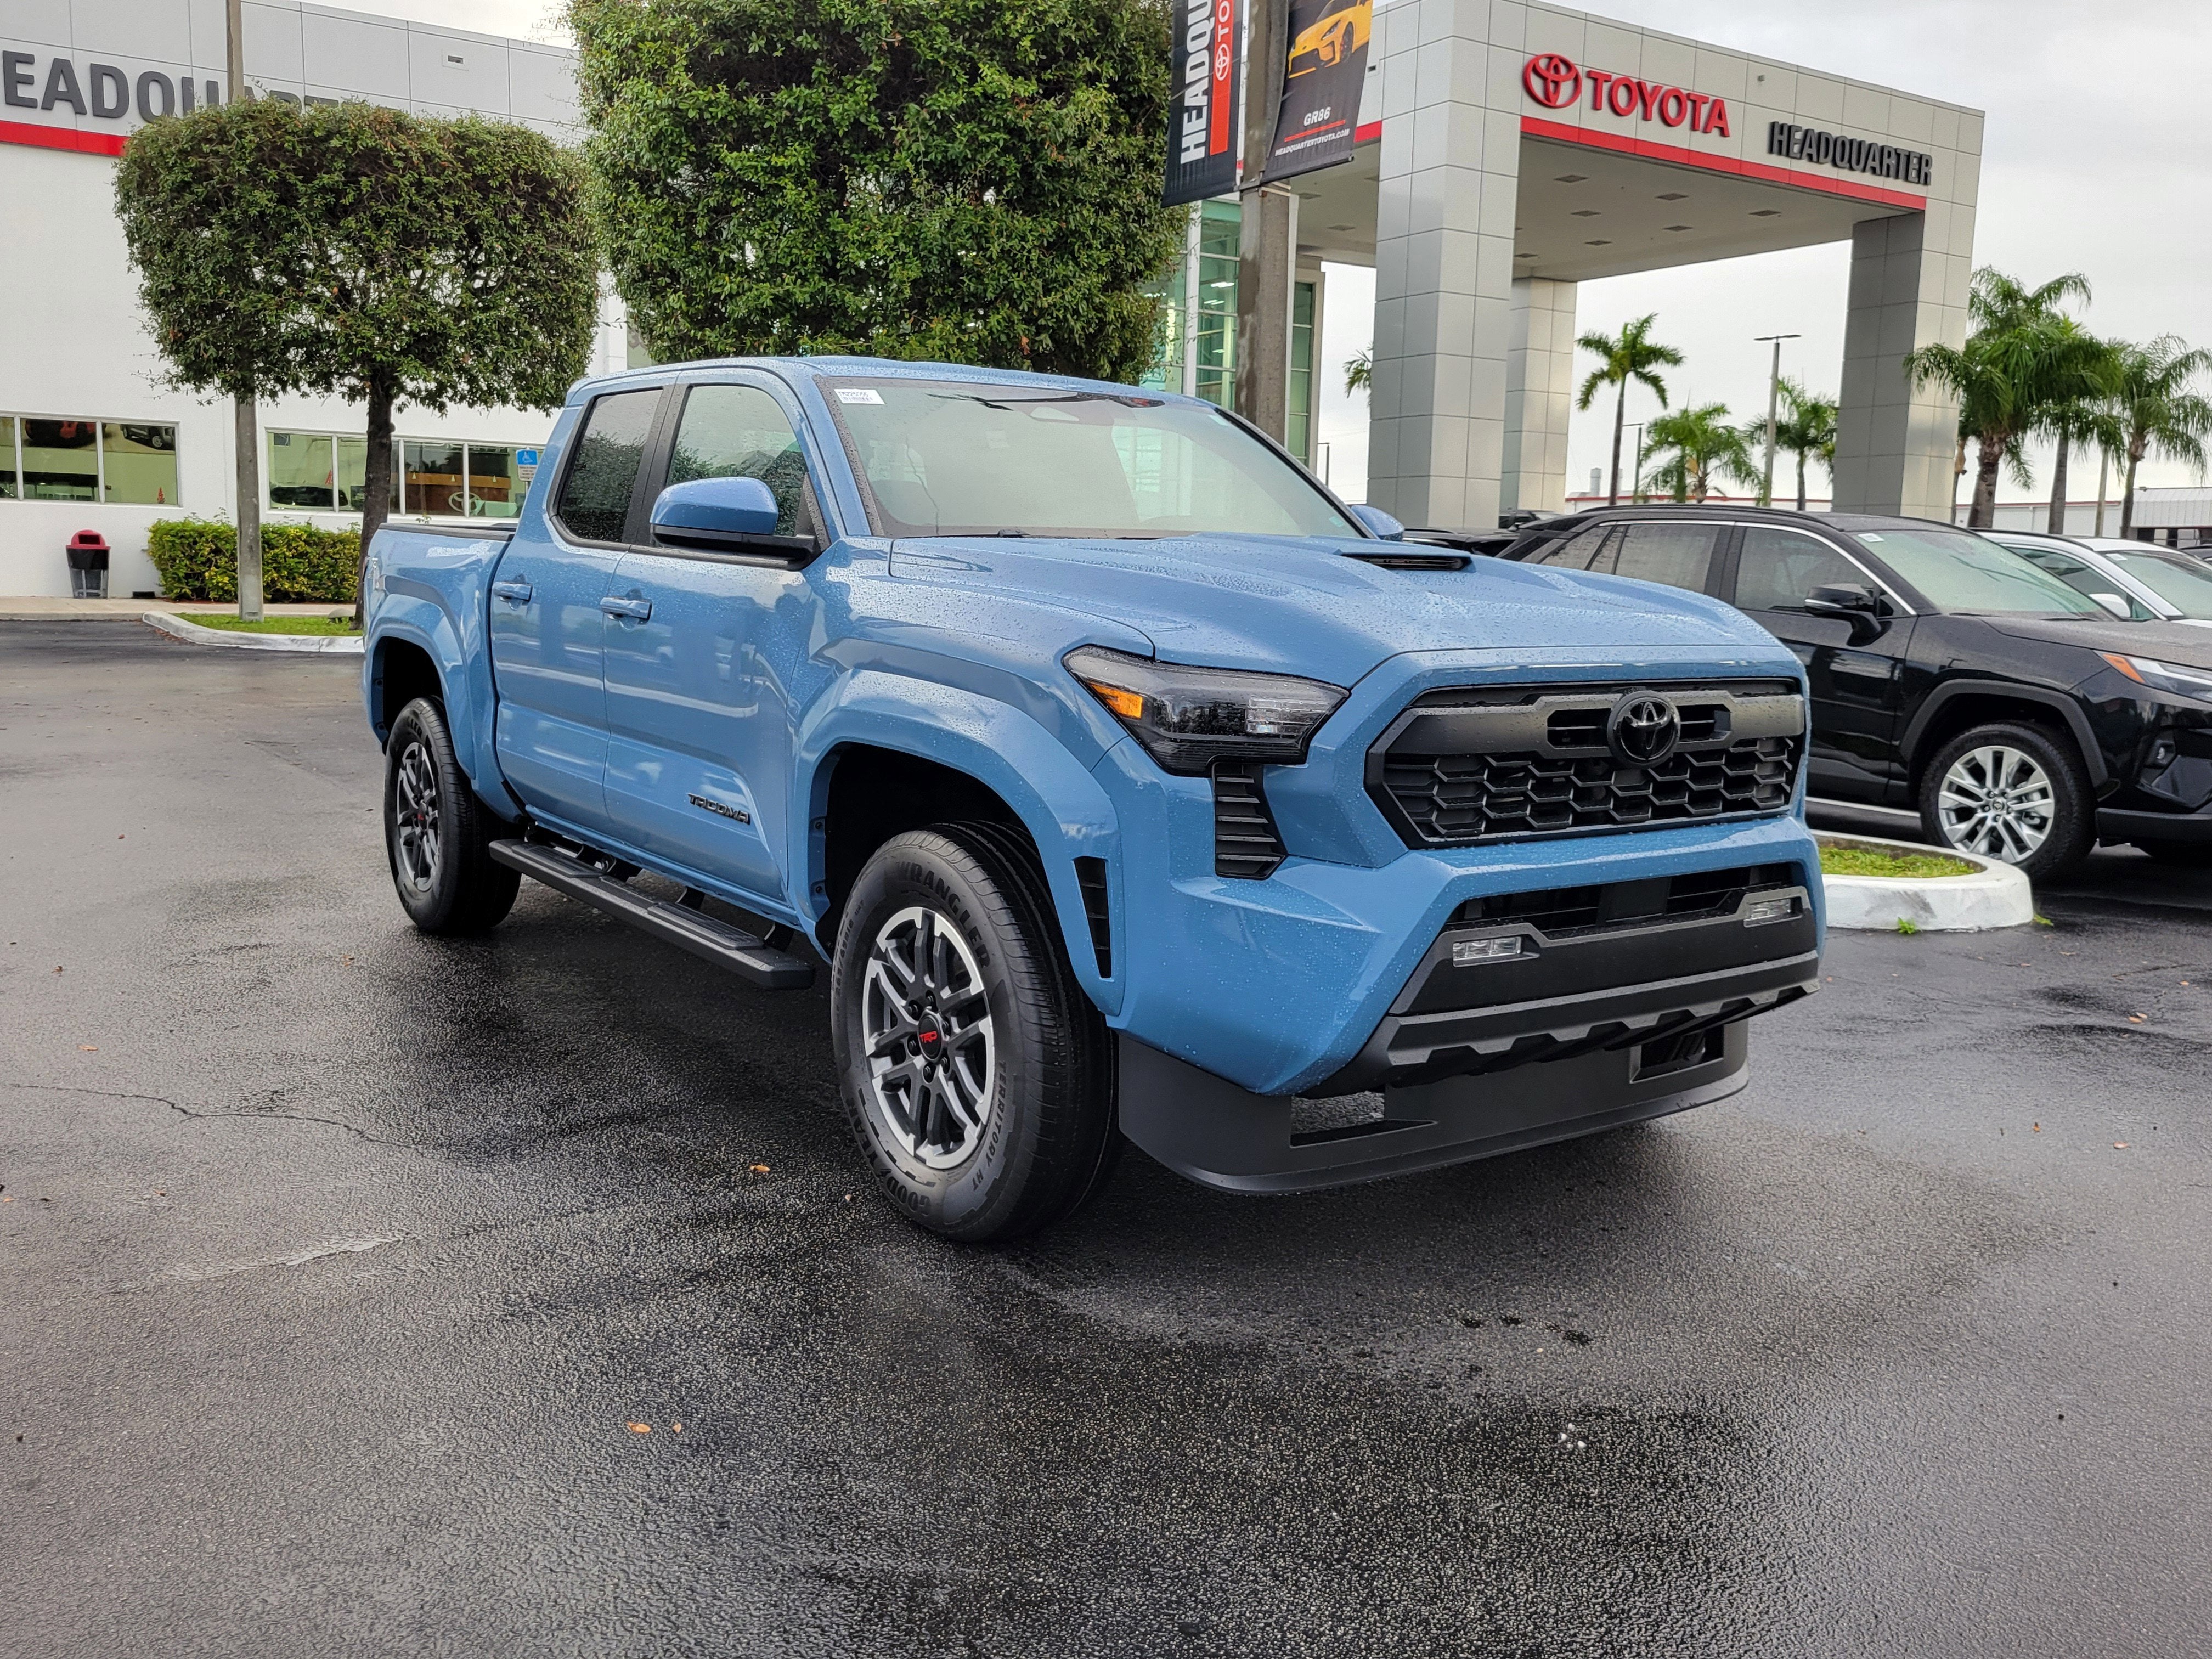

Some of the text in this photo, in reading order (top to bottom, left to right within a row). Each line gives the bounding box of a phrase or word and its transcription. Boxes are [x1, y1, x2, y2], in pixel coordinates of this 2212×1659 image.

[1218, 0, 1230, 42] TO
[1304, 106, 1331, 126] GR86
[1587, 70, 1730, 137] TOYOTA
[1275, 128, 1351, 156] HEADQUARTERTOYOTA.COM
[1768, 121, 1932, 185] HEADQUARTER
[687, 793, 751, 825] TACOMA
[919, 1031, 938, 1043] TRD
[972, 1059, 1007, 1192] TERRITORY HT
